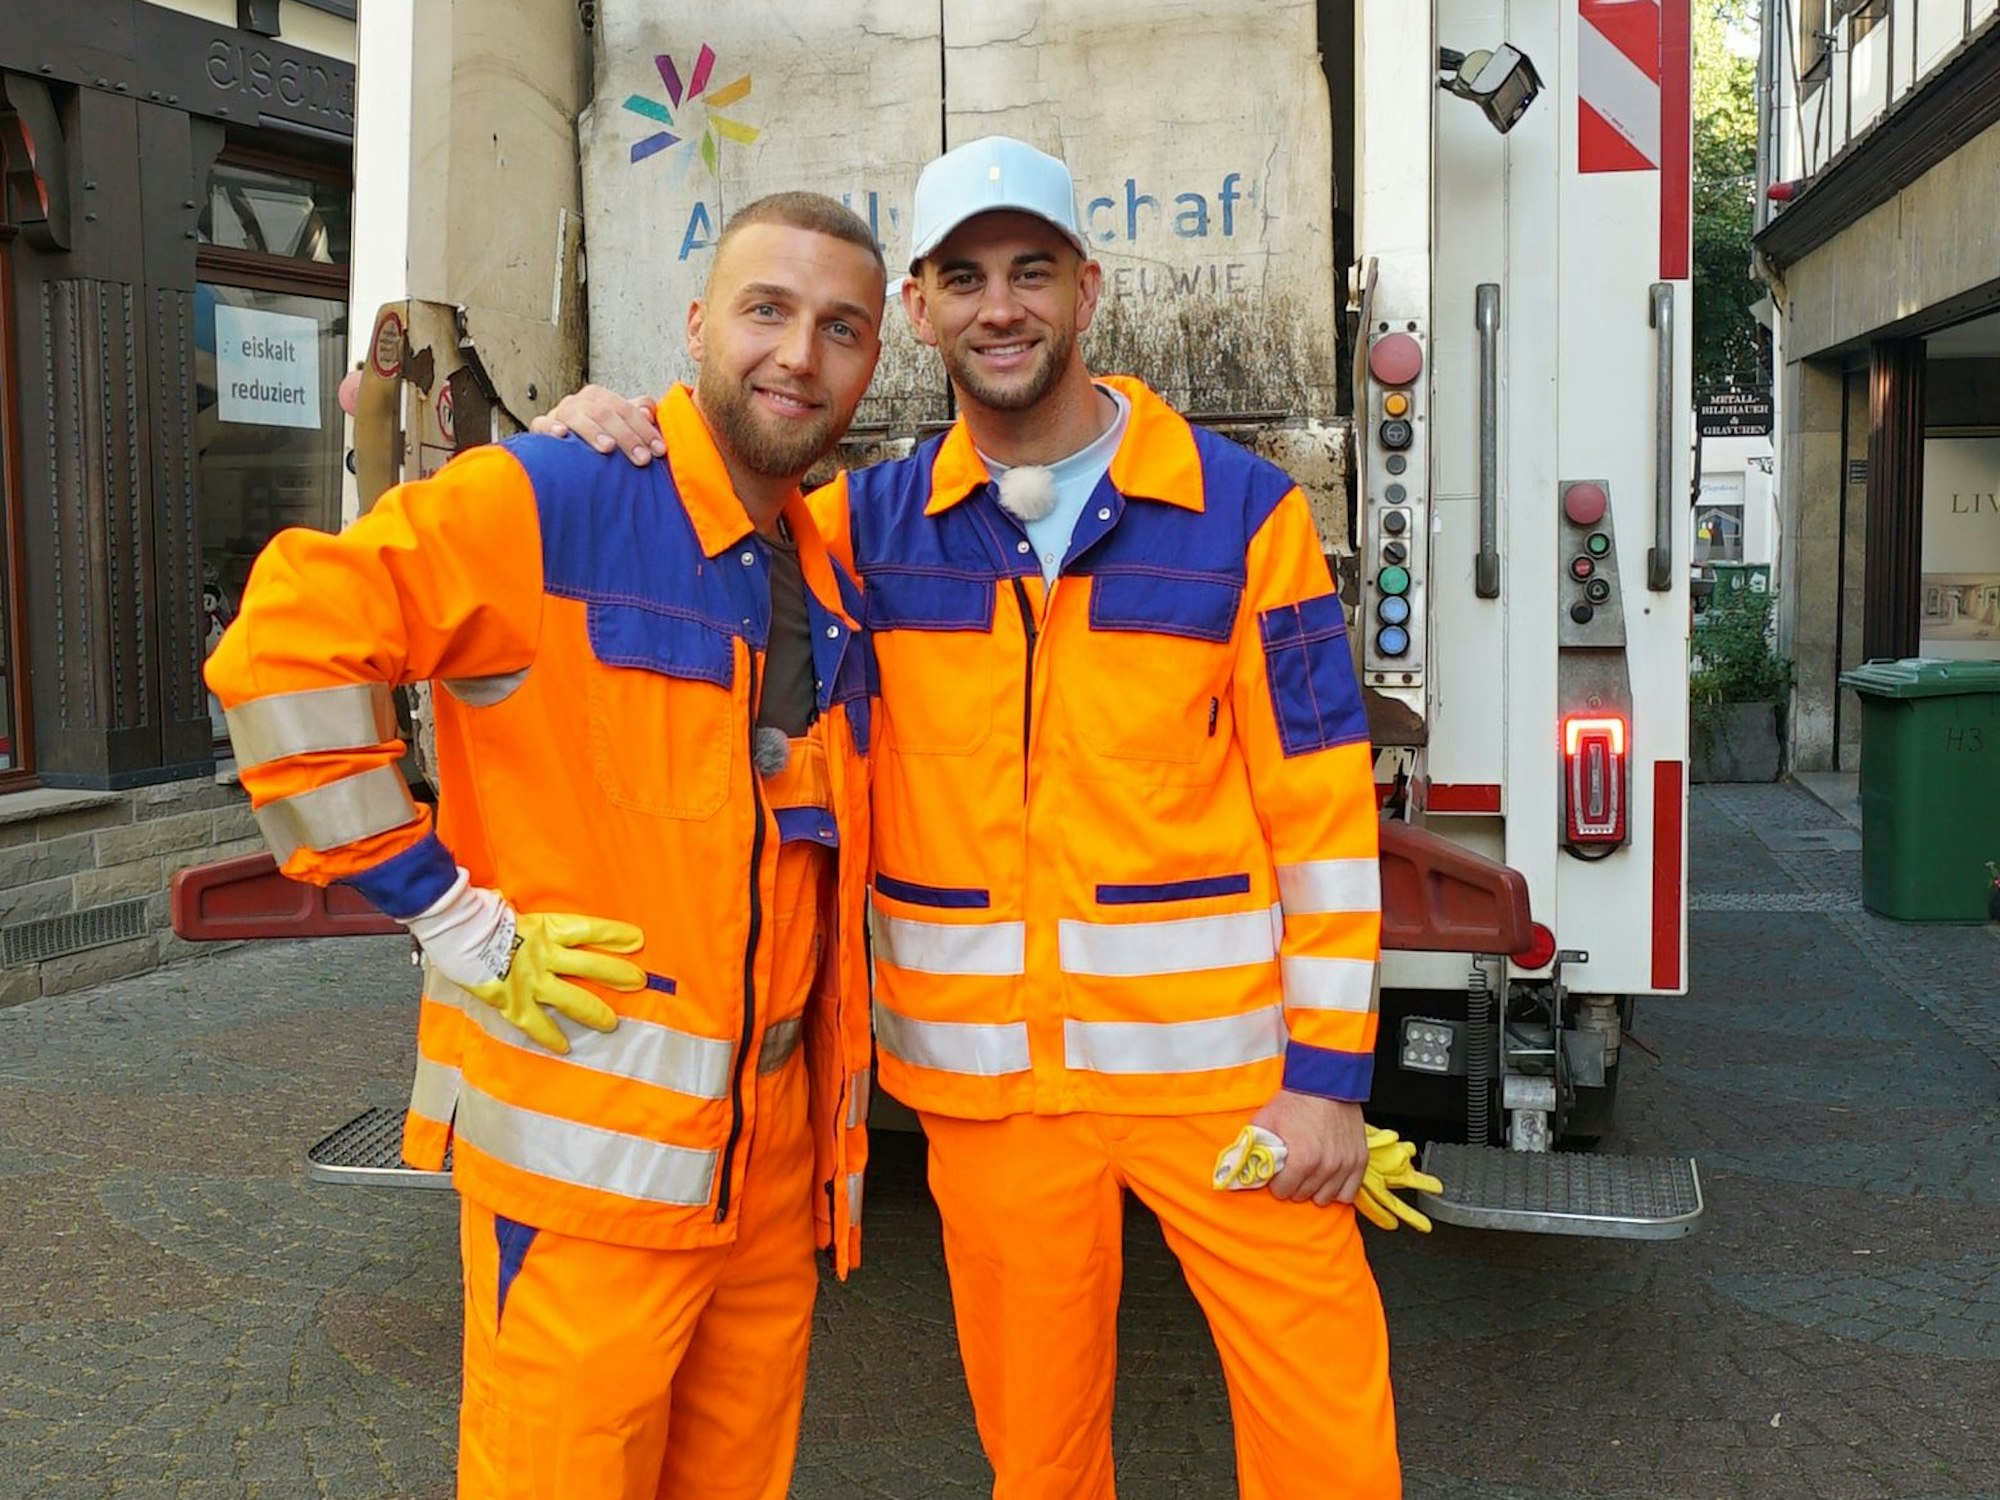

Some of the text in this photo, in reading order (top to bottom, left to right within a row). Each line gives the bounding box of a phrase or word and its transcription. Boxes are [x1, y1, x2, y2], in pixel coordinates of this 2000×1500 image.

[241, 336, 296, 362] eiskalt
[231, 378, 306, 405] reduziert
[1702, 405, 1769, 415] BILDHAUER
[1703, 425, 1766, 435] GRAVUREN
